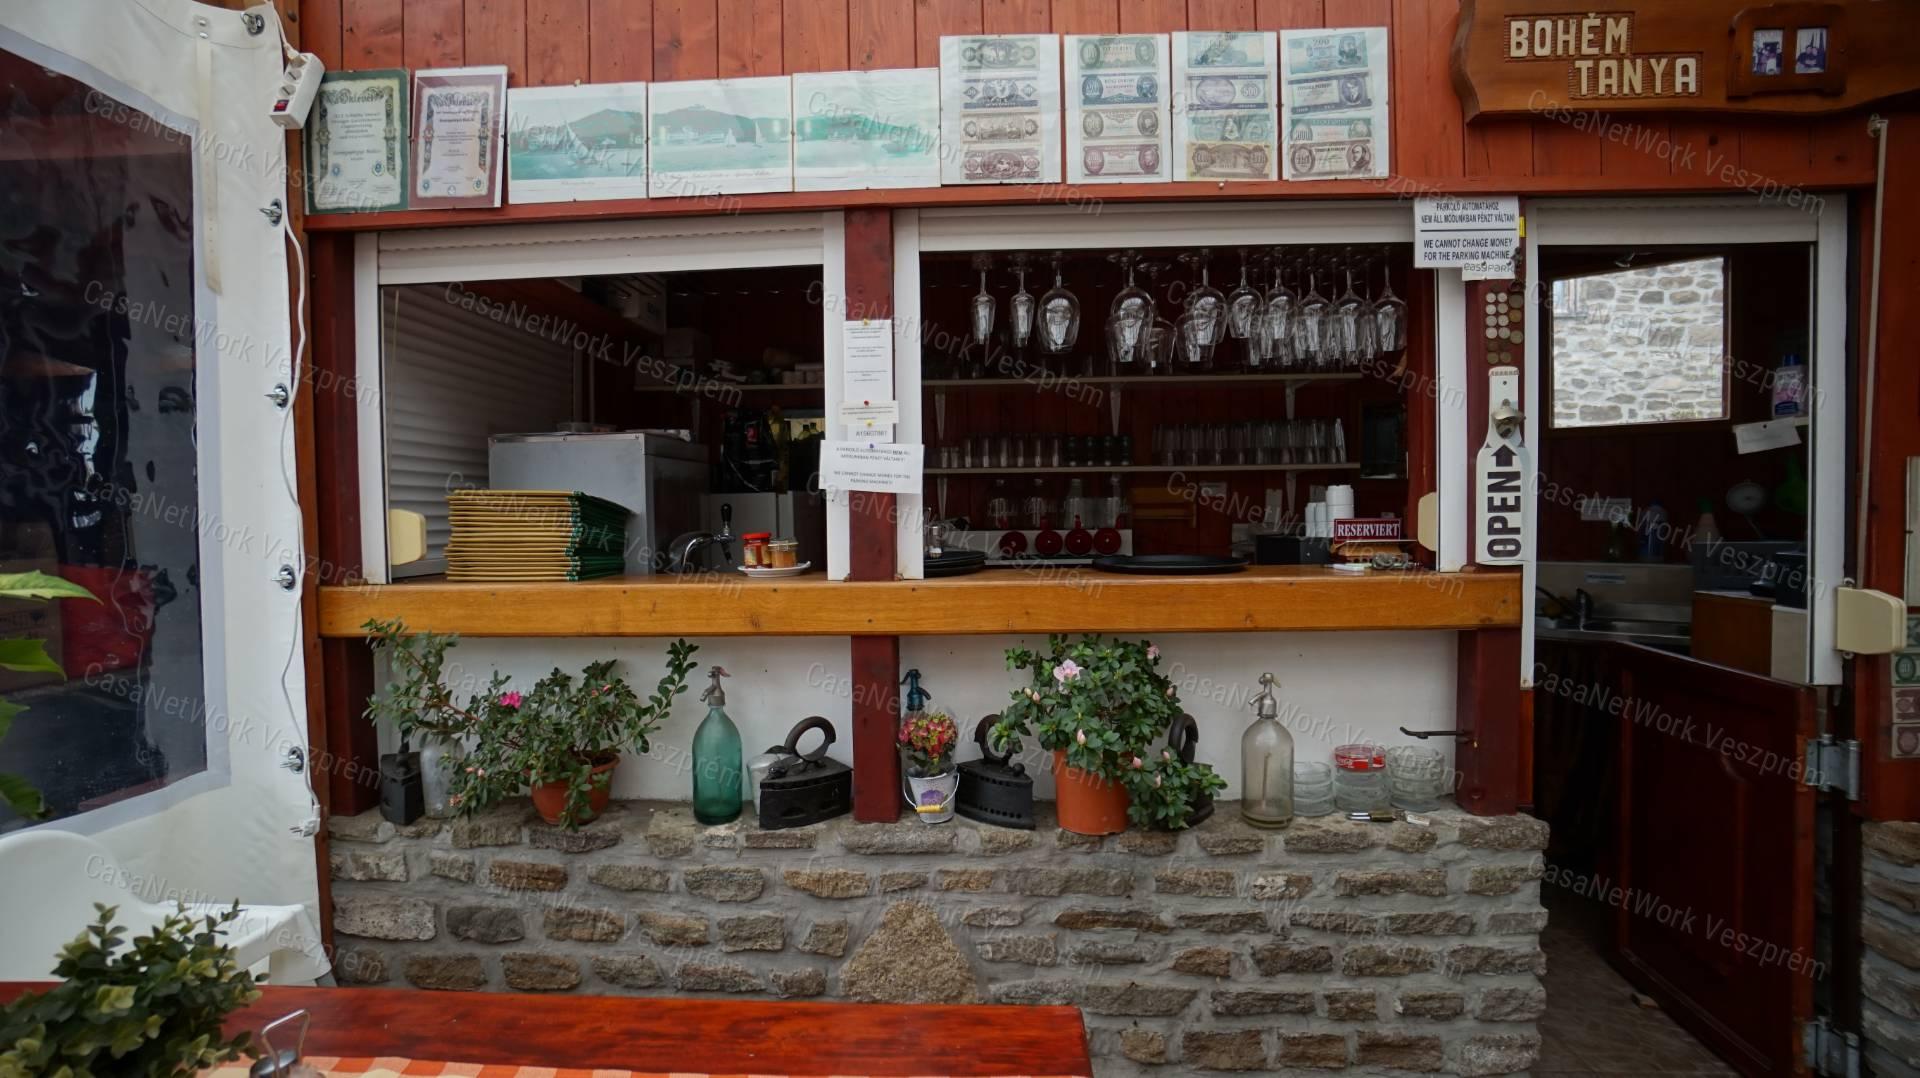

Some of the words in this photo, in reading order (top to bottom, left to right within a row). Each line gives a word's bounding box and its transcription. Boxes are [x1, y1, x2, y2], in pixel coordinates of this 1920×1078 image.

[1509, 13, 1630, 58] BOHÉM
[1574, 57, 1697, 97] TANYA
[1421, 214, 1433, 223] NEM
[1434, 212, 1443, 223] ÁLL
[1477, 212, 1493, 222] PÉNZT
[1424, 239, 1433, 248] WE
[1435, 239, 1460, 248] CANNOT
[1462, 238, 1488, 247] CHANGE
[1490, 238, 1512, 247] MONEY
[1424, 252, 1437, 260] FOR
[1438, 251, 1451, 260] THE
[1452, 251, 1480, 260] PARKING
[1485, 470, 1522, 559] OPEN
[1337, 523, 1400, 537] RESERVIERT
